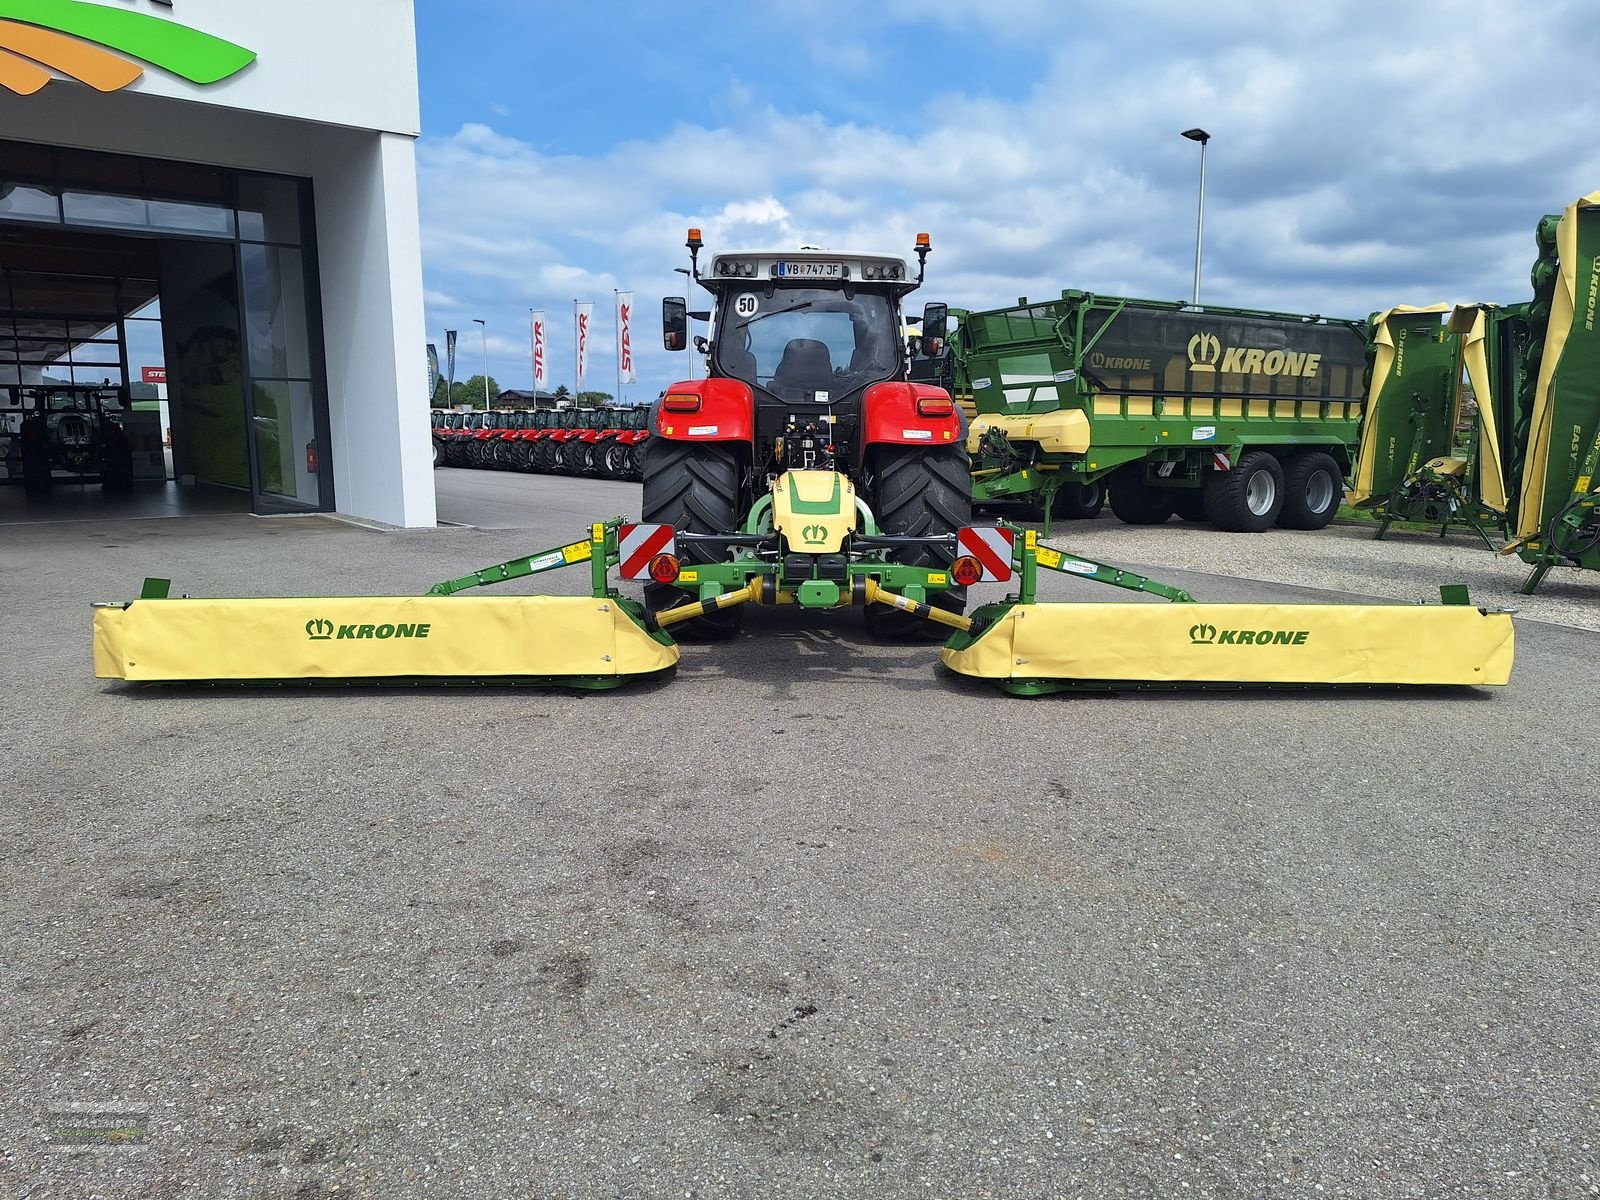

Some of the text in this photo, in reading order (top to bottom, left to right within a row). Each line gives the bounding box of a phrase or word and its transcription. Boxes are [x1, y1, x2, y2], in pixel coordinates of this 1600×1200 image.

[786, 264, 838, 275] VB 747 JF
[739, 297, 755, 312] 50
[1585, 273, 1599, 331] KRONE
[534, 321, 543, 380] STEYR
[579, 313, 588, 377] EYR
[620, 303, 630, 373] STEYR
[1104, 357, 1151, 370] KRONE
[1220, 347, 1321, 378] KRONE
[1396, 340, 1407, 377] KRONE
[336, 624, 431, 639] KRONE
[1217, 630, 1310, 645] KRONE
